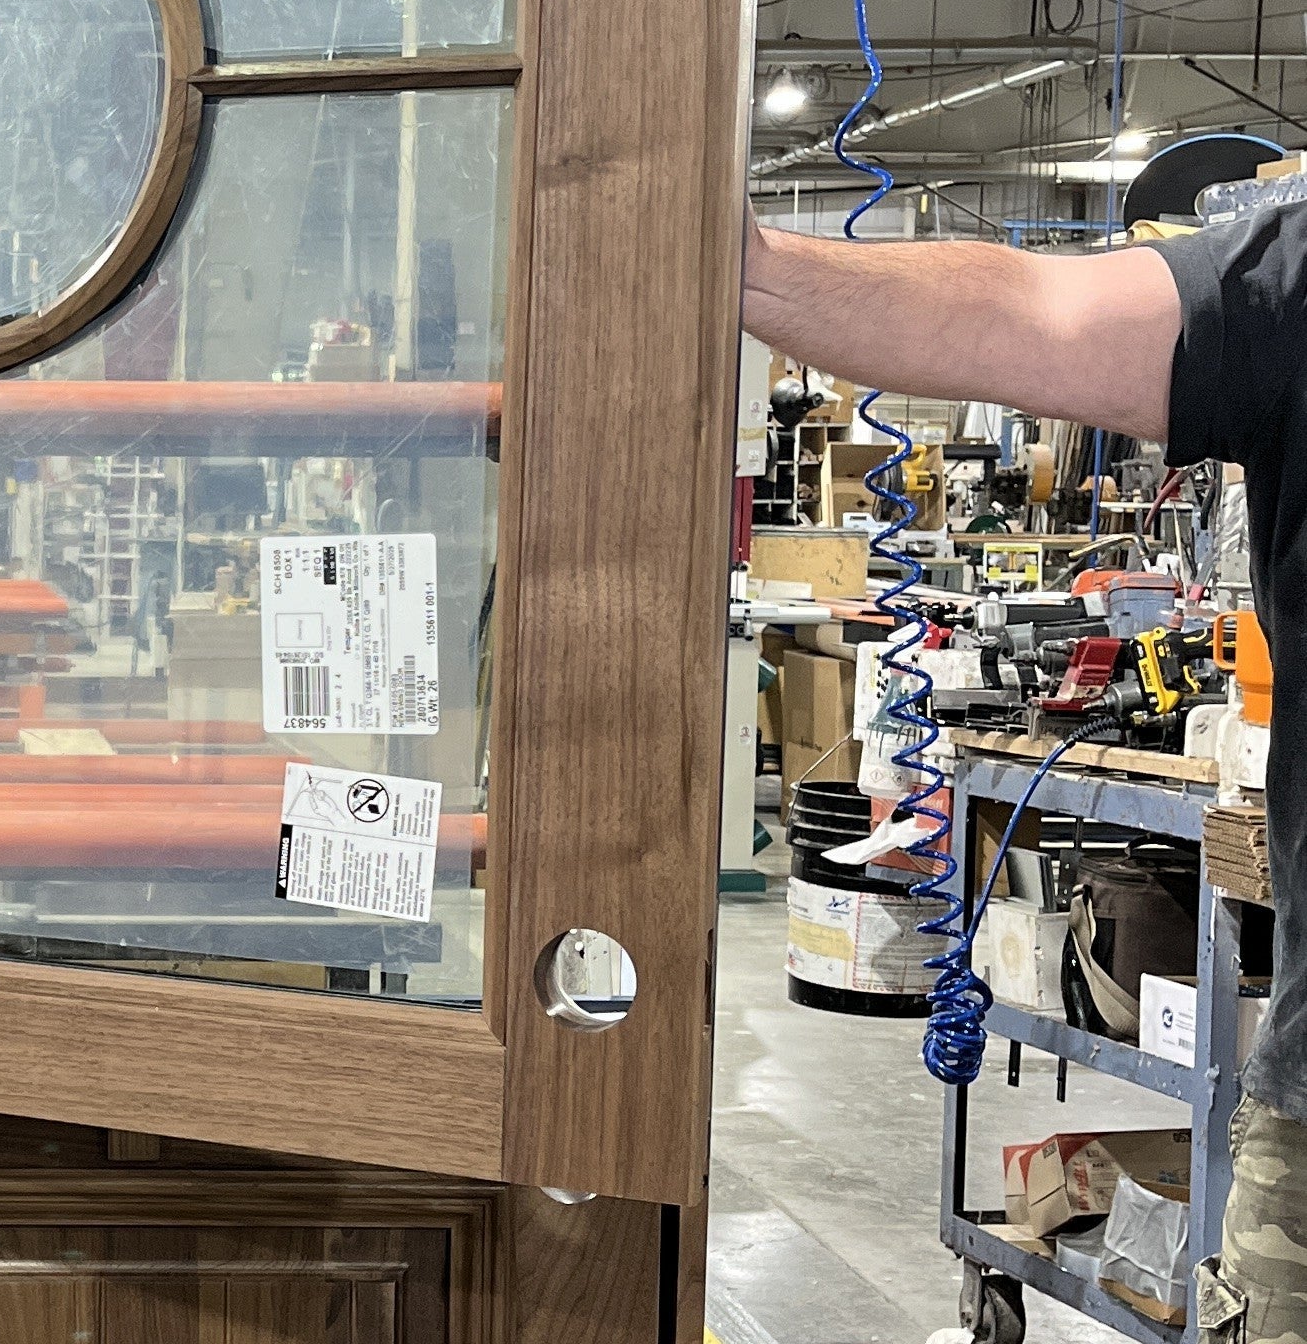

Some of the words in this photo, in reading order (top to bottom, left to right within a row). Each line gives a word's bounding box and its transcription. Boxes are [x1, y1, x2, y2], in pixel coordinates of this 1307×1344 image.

[427, 609, 435, 645] 1355611
[428, 680, 437, 691] 26
[284, 718, 326, 728] 564837
[279, 837, 290, 879] WARNING
